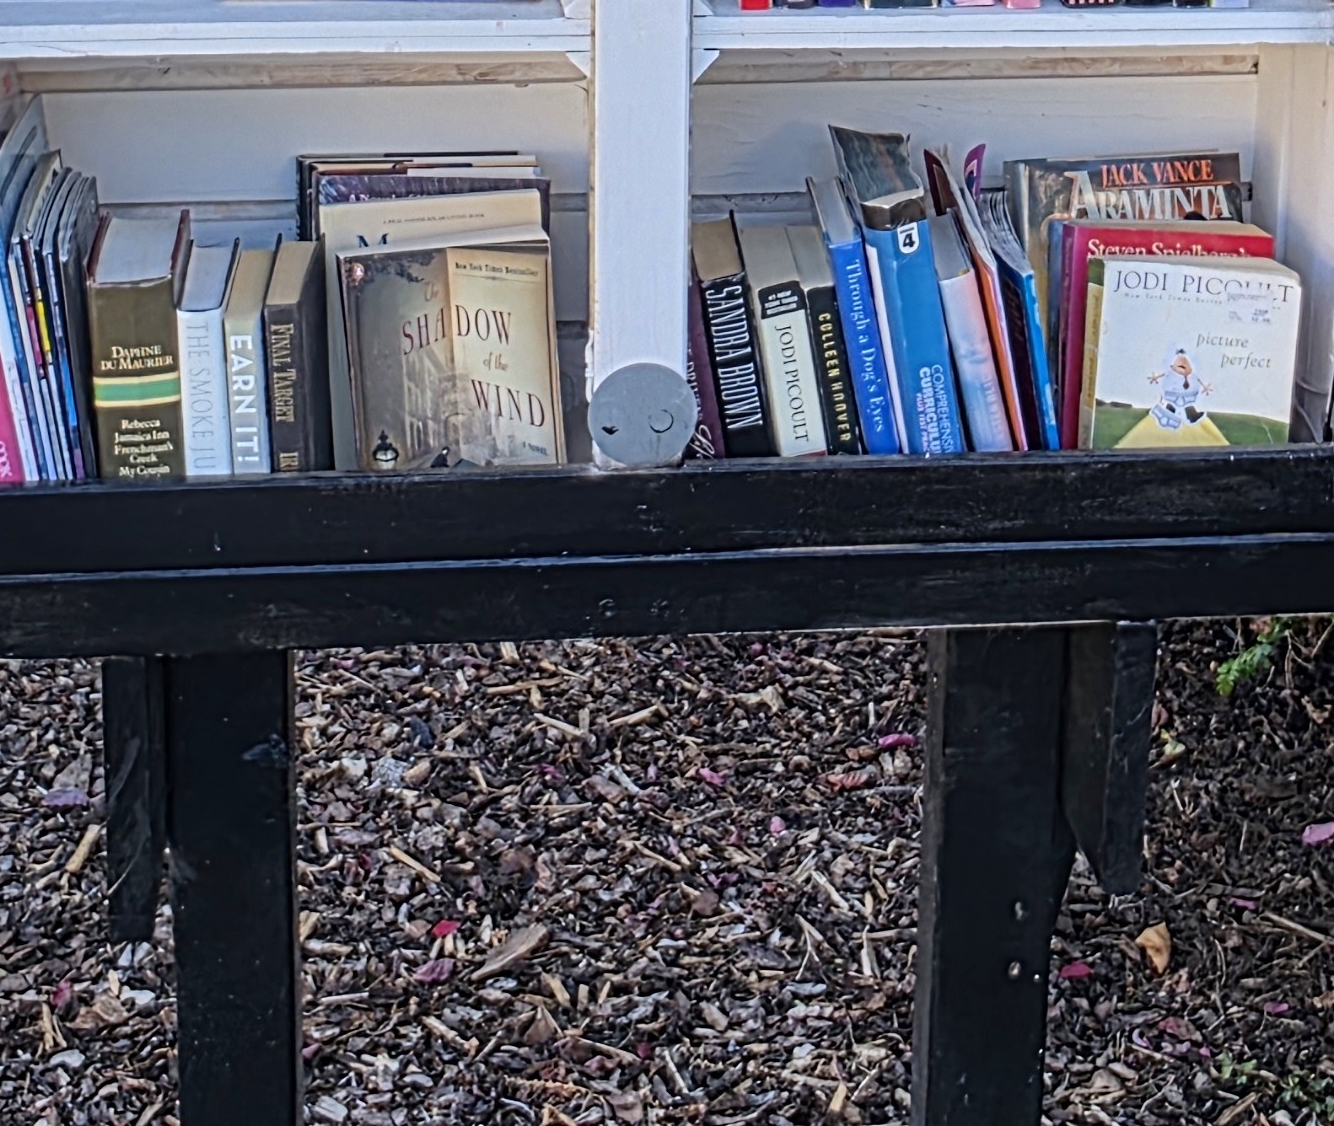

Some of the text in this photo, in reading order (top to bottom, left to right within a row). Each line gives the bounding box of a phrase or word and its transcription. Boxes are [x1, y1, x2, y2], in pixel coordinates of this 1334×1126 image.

[1100, 160, 1214, 187] JACK VANCE
[1064, 170, 1233, 220] ARAMINTA
[902, 232, 916, 249] 4
[1114, 270, 1167, 293] JODI
[186, 322, 209, 361] THE
[402, 304, 512, 357] SHADOW
[845, 259, 886, 433] Through a Dog's Eyes
[1196, 332, 1249, 348] picture
[101, 355, 174, 370] DU MAURIER
[111, 345, 162, 359] DAPHNE
[483, 352, 509, 372] of the
[704, 285, 763, 430] SANDRA BROWN
[1220, 352, 1271, 370] perfect
[270, 323, 297, 423] FINAL TARGET
[775, 325, 809, 443] JODI PICOULT
[818, 313, 851, 442] COLLEEN HOOVER
[188, 363, 213, 440] SMOKE
[230, 334, 260, 463] EARN IT!
[471, 378, 546, 428] WIND
[115, 430, 170, 443] Jamaica Inn
[121, 419, 161, 429] Rebecca
